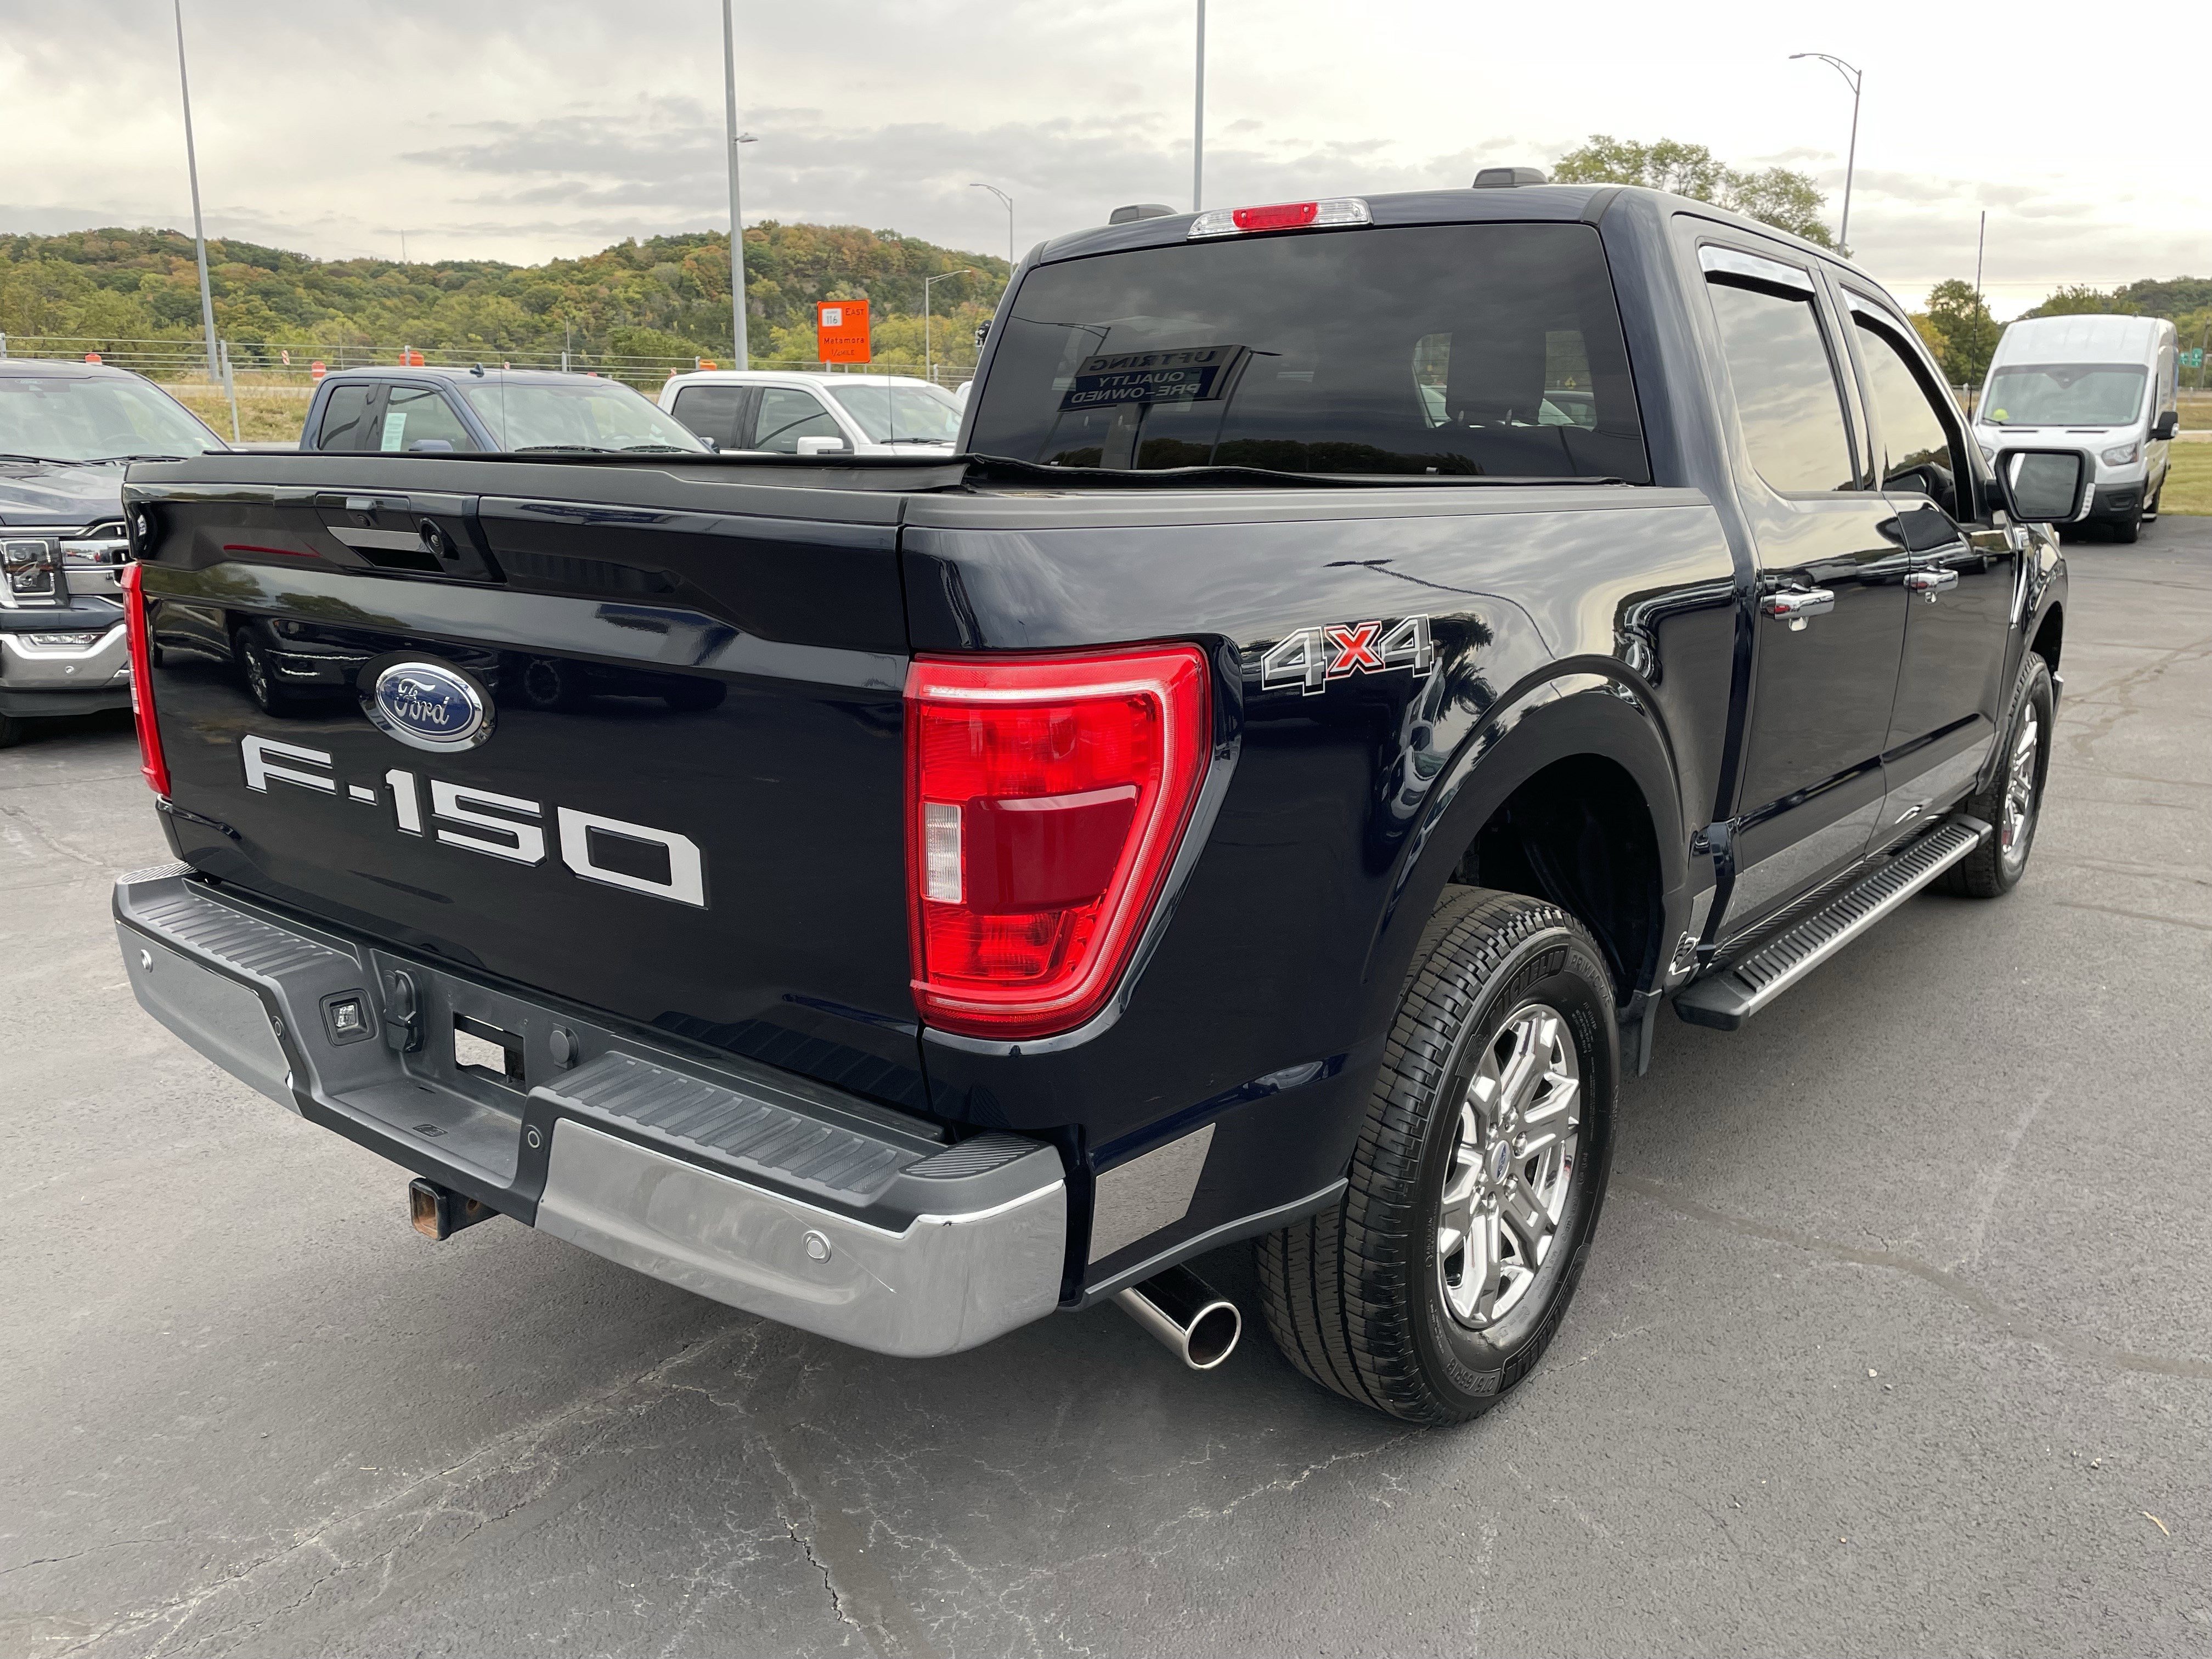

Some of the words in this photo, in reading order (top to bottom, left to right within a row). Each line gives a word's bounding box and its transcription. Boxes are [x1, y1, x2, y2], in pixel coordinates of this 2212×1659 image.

[826, 315, 837, 324] 116
[393, 676, 450, 726] Ford
[241, 734, 708, 910] F-150
